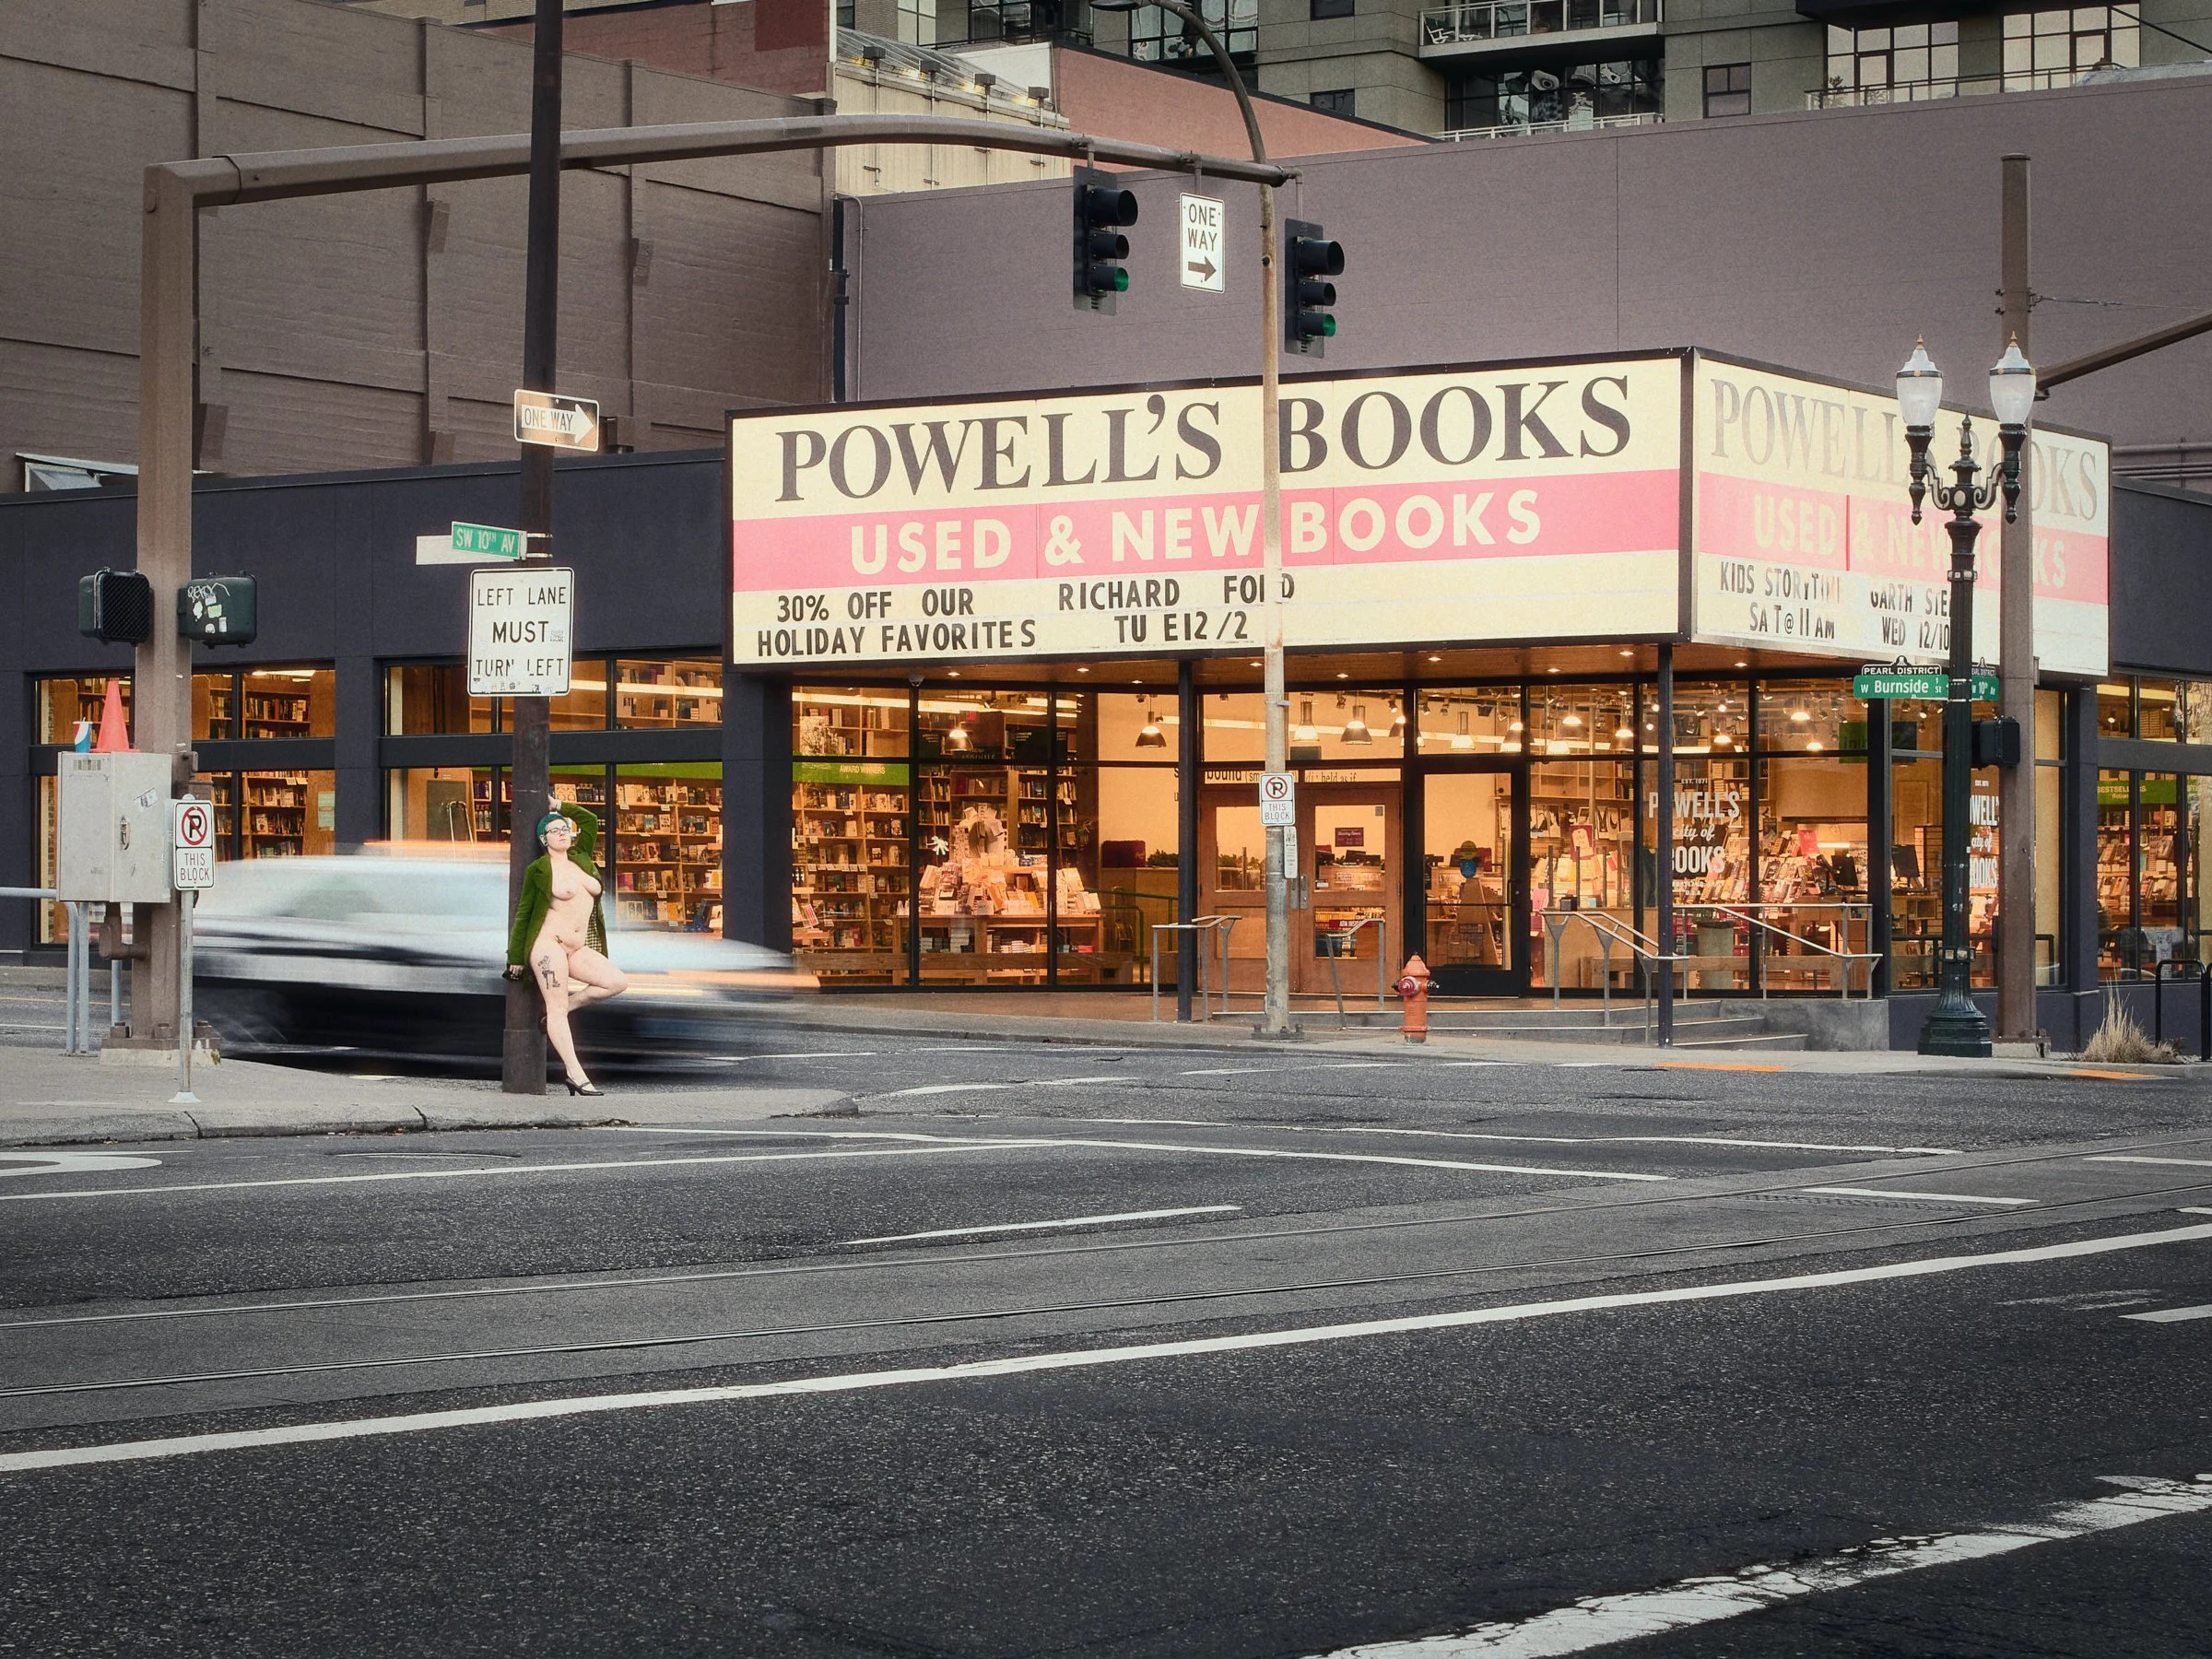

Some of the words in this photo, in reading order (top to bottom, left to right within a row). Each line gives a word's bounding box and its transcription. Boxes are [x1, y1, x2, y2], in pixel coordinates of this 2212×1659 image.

[1189, 204, 1216, 227] ONE
[1188, 228, 1217, 251] WAY
[524, 407, 547, 428] ONE
[550, 411, 573, 431] WAY
[775, 394, 1222, 501] POWELL'S
[1278, 375, 1630, 474] BOOKS
[1711, 379, 1938, 494] POWELL
[851, 519, 1011, 575] USED
[1044, 515, 1085, 566] &
[1112, 504, 1260, 561] NEW
[1290, 489, 1541, 554] BOOKS
[1755, 492, 1836, 557] USED
[1853, 511, 1875, 560] &
[456, 527, 472, 547] SW
[501, 535, 516, 553] AV
[1720, 561, 1755, 594] KIDS
[477, 588, 513, 606] LEFT
[528, 586, 567, 605] LANE
[777, 594, 829, 622] 30%
[848, 591, 892, 619] OFF
[922, 588, 974, 616] OUR
[1059, 578, 1180, 611] RICHARD
[493, 621, 549, 643] MUST
[758, 626, 865, 656] HOLIDAY
[882, 619, 1036, 652] FAVORITES
[1882, 616, 1906, 647] WED
[476, 659, 514, 677] TURN
[527, 658, 564, 677] LEFT
[1897, 666, 1939, 675] DISTRICT
[1875, 679, 1929, 693] Burnside
[840, 764, 859, 773] AWARD
[861, 766, 886, 774] WINNERS
[1265, 812, 1289, 820] BLOCK
[1649, 791, 1740, 818] PWELL'S
[1700, 823, 1716, 841] of
[184, 853, 206, 866] THIS
[180, 867, 210, 881] BLOCK
